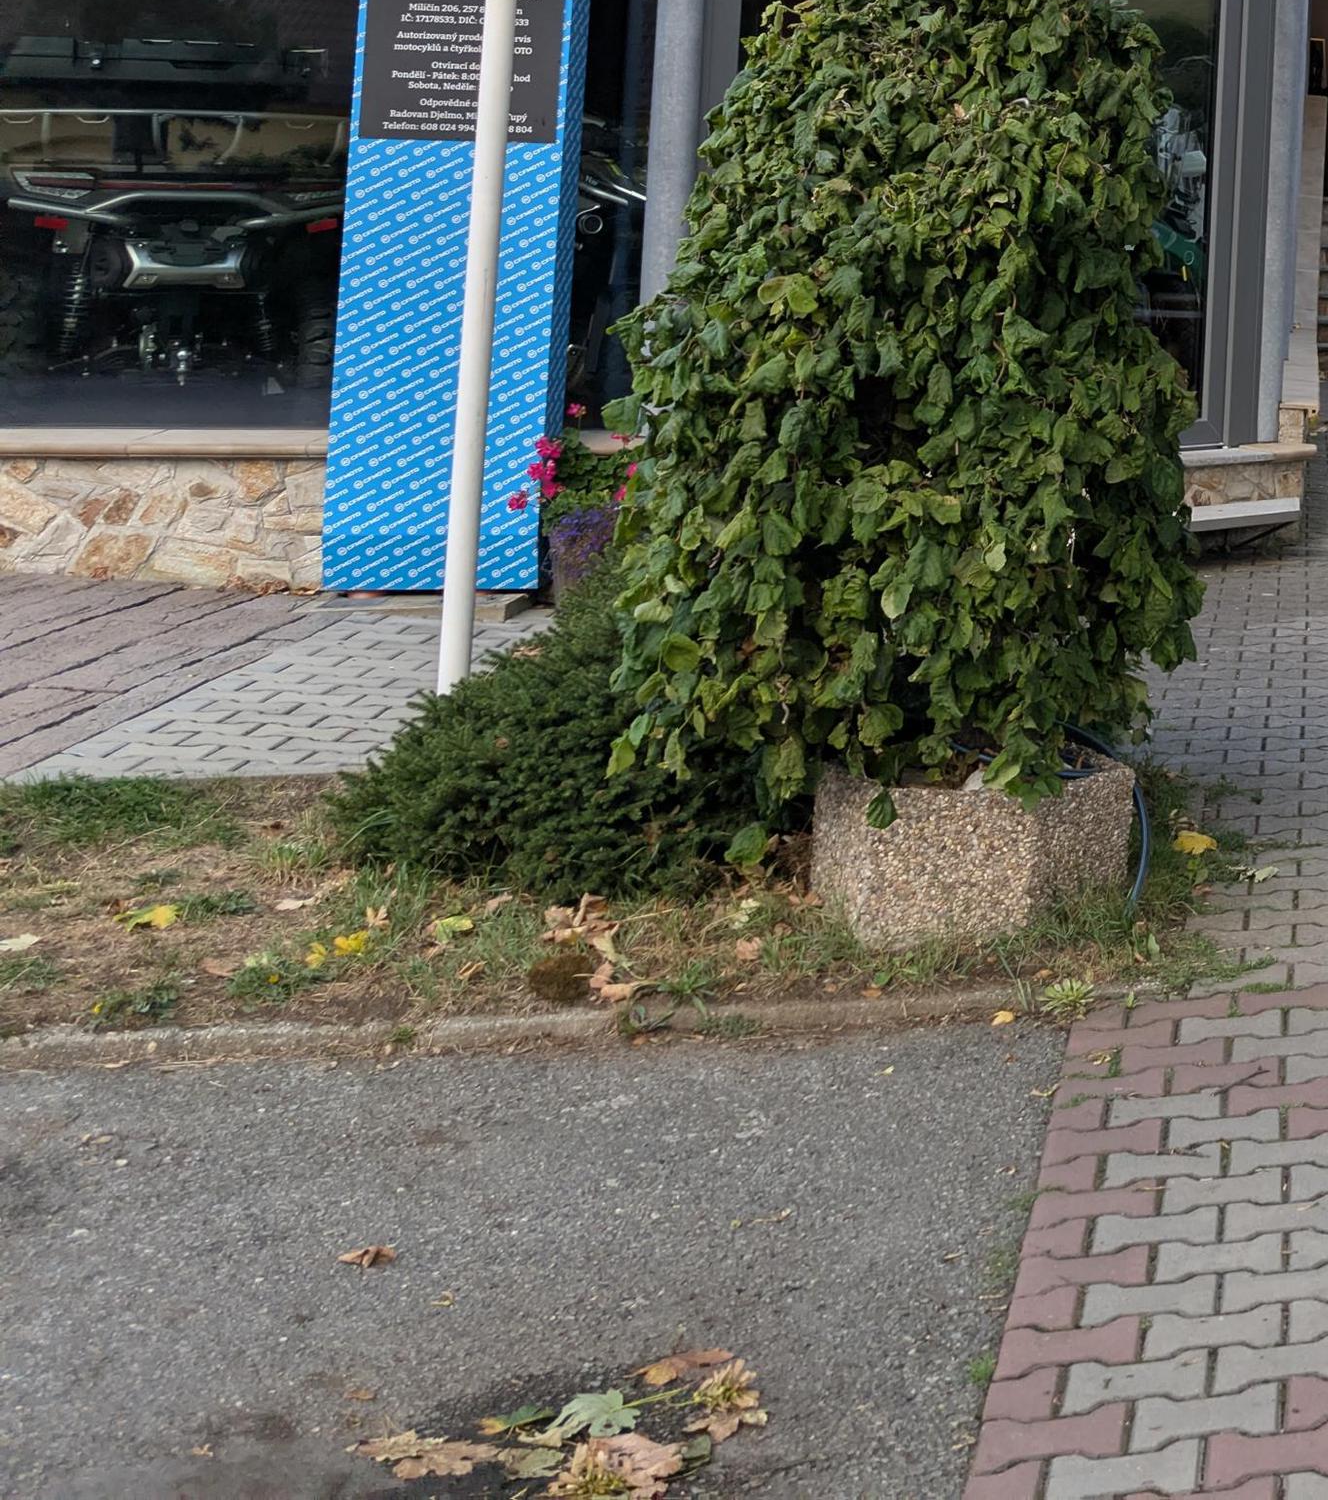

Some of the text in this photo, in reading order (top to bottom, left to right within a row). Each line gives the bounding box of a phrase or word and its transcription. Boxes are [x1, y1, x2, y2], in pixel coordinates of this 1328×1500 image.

[442, 4, 461, 13] 206,
[463, 5, 478, 13] 257
[401, 14, 414, 22] IČ:
[459, 15, 478, 24] DIČ:
[396, 31, 457, 41] Autorizovaný
[394, 43, 441, 52] motocyklů
[450, 45, 483, 54] čtyřkol
[391, 71, 425, 79] Pondělí
[432, 71, 459, 80] Pátek:
[514, 74, 531, 82] hod
[408, 81, 441, 90] Sobota,
[443, 82, 476, 91] Neděle:
[419, 99, 470, 109] Odpovědné
[390, 110, 428, 119] Radovan
[430, 111, 464, 120] Djelmo,
[383, 122, 419, 130] Telefon:
[420, 123, 437, 131] 608
[439, 123, 456, 131] 024
